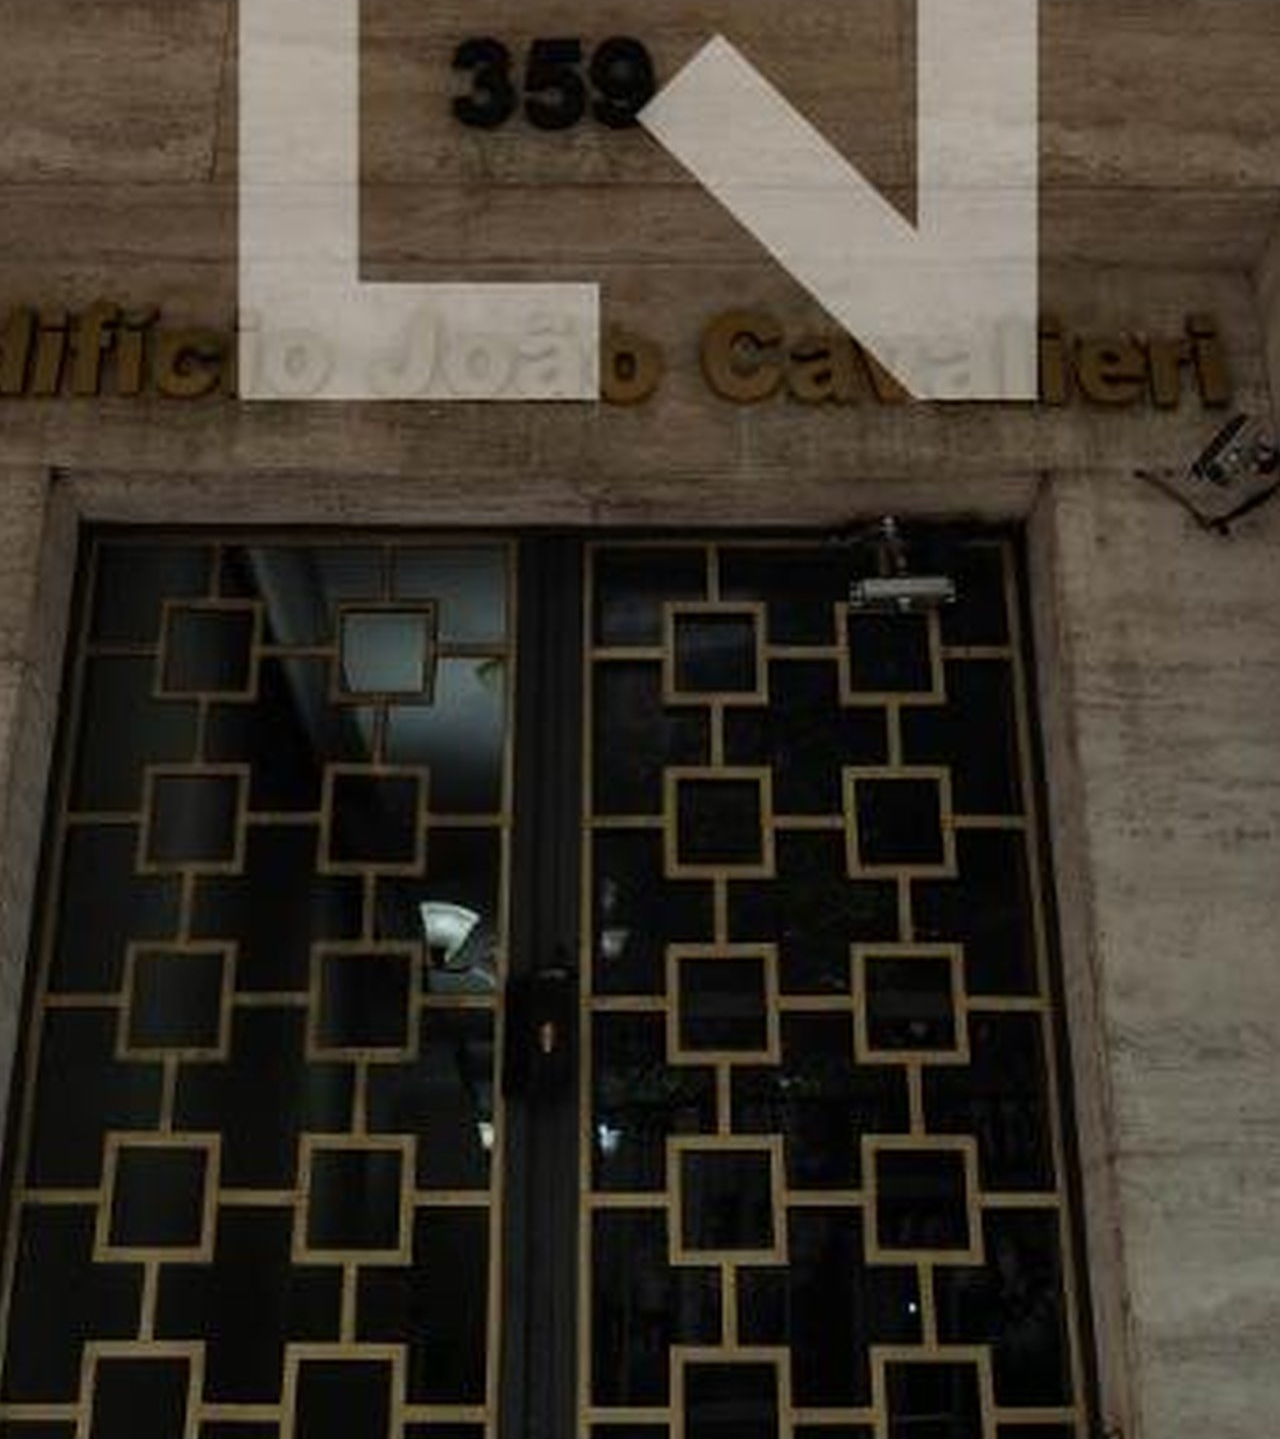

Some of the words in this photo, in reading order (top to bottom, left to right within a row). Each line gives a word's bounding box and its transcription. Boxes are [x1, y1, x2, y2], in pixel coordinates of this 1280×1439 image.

[450, 36, 655, 130] 359
[367, 299, 665, 406] João
[699, 306, 1232, 409] Cavalieri
